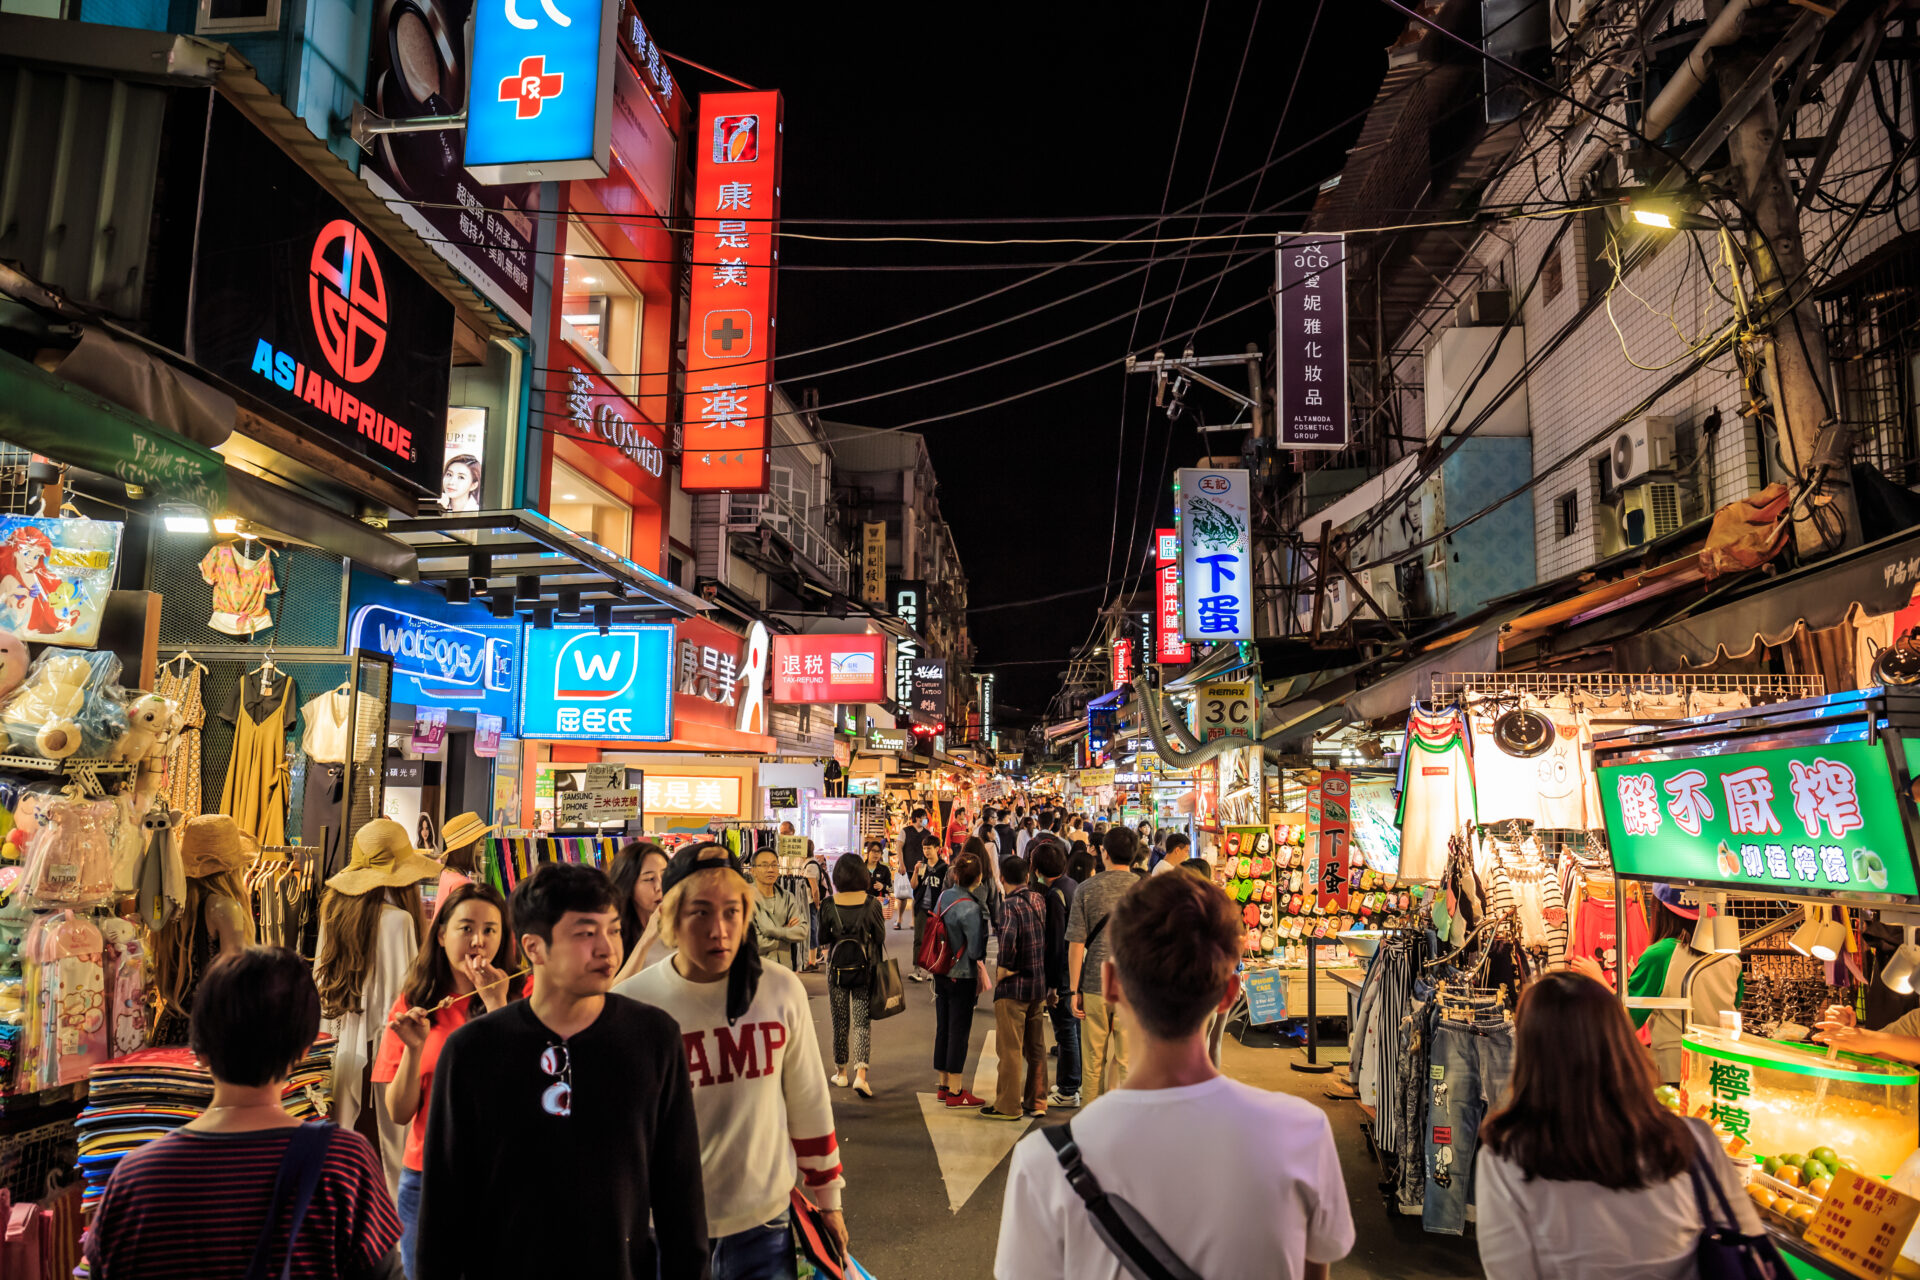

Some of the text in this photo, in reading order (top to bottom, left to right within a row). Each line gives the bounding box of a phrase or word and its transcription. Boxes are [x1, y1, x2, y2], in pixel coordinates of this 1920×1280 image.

[632, 15, 674, 101] 康是美
[712, 181, 753, 289] 康是美
[1303, 272, 1323, 406] 愛妮雅化妝品
[251, 338, 413, 461] ASIANPRIDE
[600, 404, 664, 478] COSMED
[1202, 479, 1228, 490] 王記
[1195, 553, 1240, 635] 下蛋
[379, 622, 472, 667] watsons
[574, 650, 621, 681] W
[1117, 648, 1127, 679] Tomod's
[678, 639, 737, 707] 康是美
[1208, 688, 1245, 696] REMAX
[556, 707, 633, 733] 屈臣氏
[1205, 700, 1250, 724] 3C
[563, 792, 594, 801] SAMSUNG
[1325, 782, 1346, 792] 王記
[1617, 757, 1865, 840] 鮮不厭榨
[562, 812, 583, 822] Type-C
[1320, 828, 1347, 895] 下蛋
[1740, 842, 1850, 884] 柳橙檸檬
[1709, 1060, 1751, 1145] 檸檬
